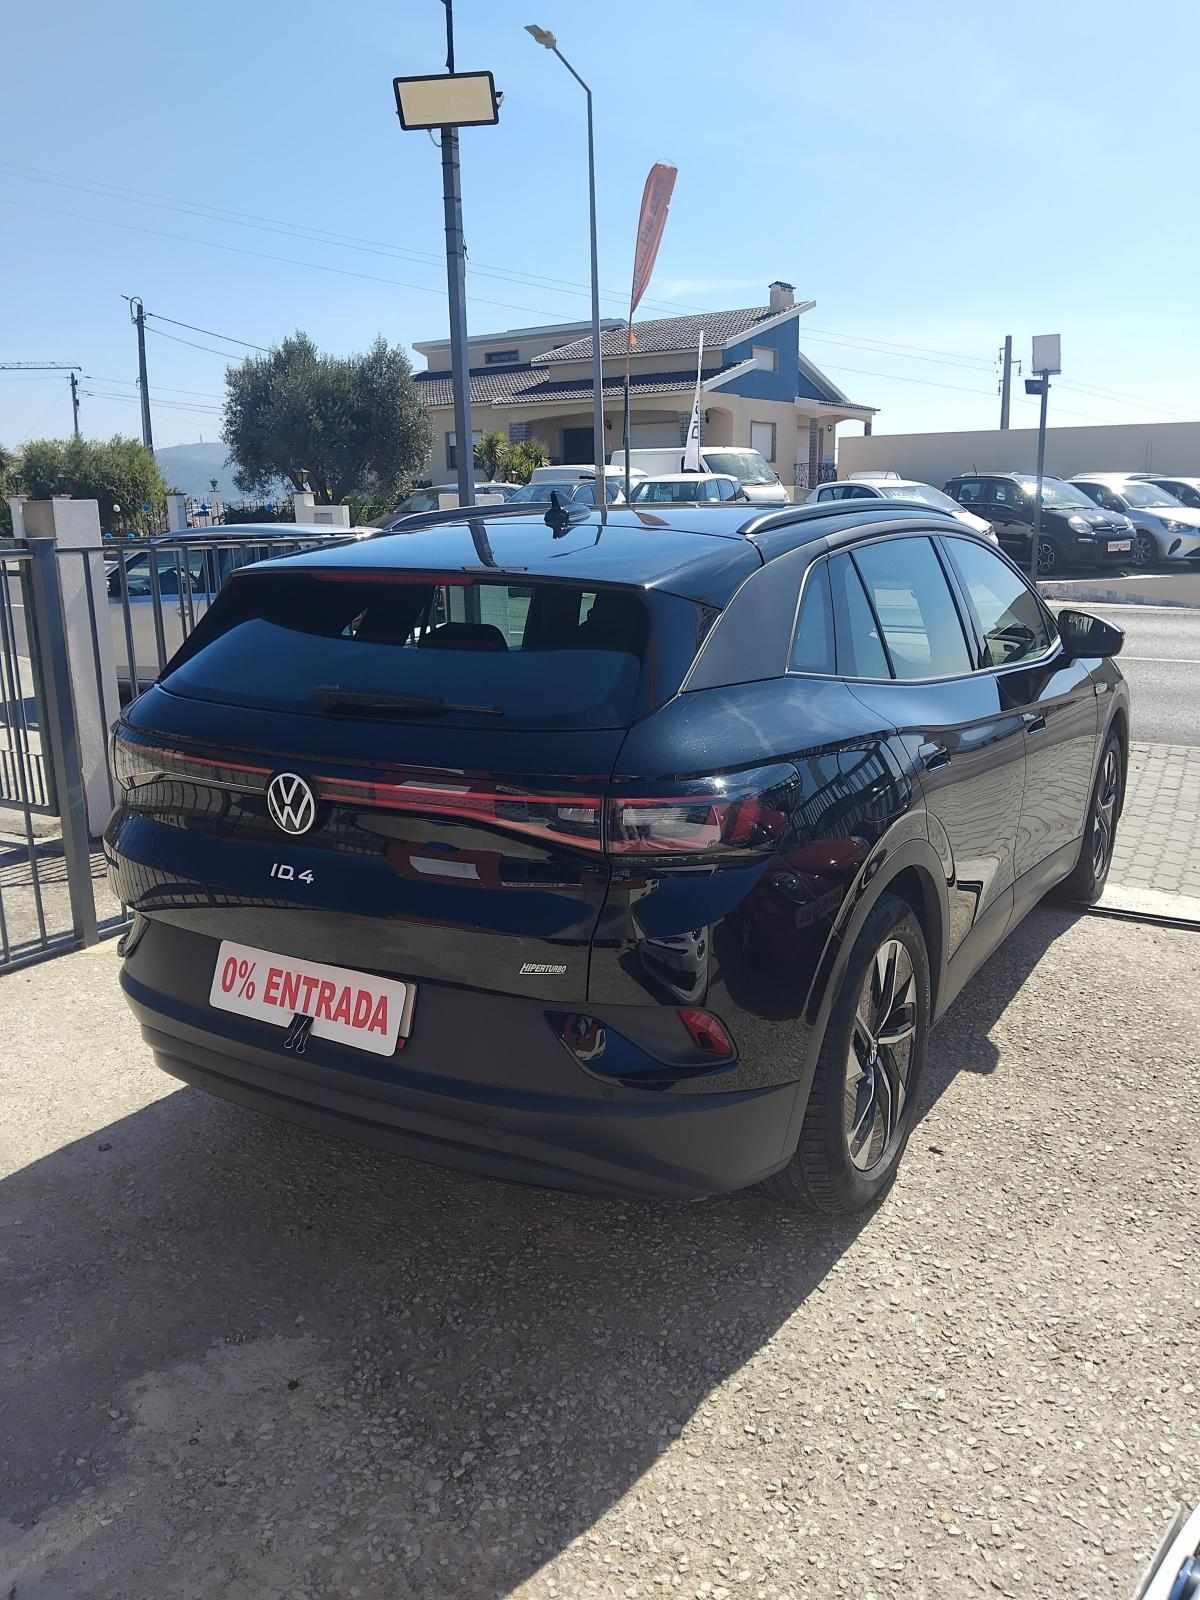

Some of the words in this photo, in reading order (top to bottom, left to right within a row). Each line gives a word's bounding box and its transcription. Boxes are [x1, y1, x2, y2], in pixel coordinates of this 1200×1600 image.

[520, 962, 567, 975] HIPERTURBO
[221, 956, 257, 1001] 0%
[263, 967, 388, 1036] ENTRADA
